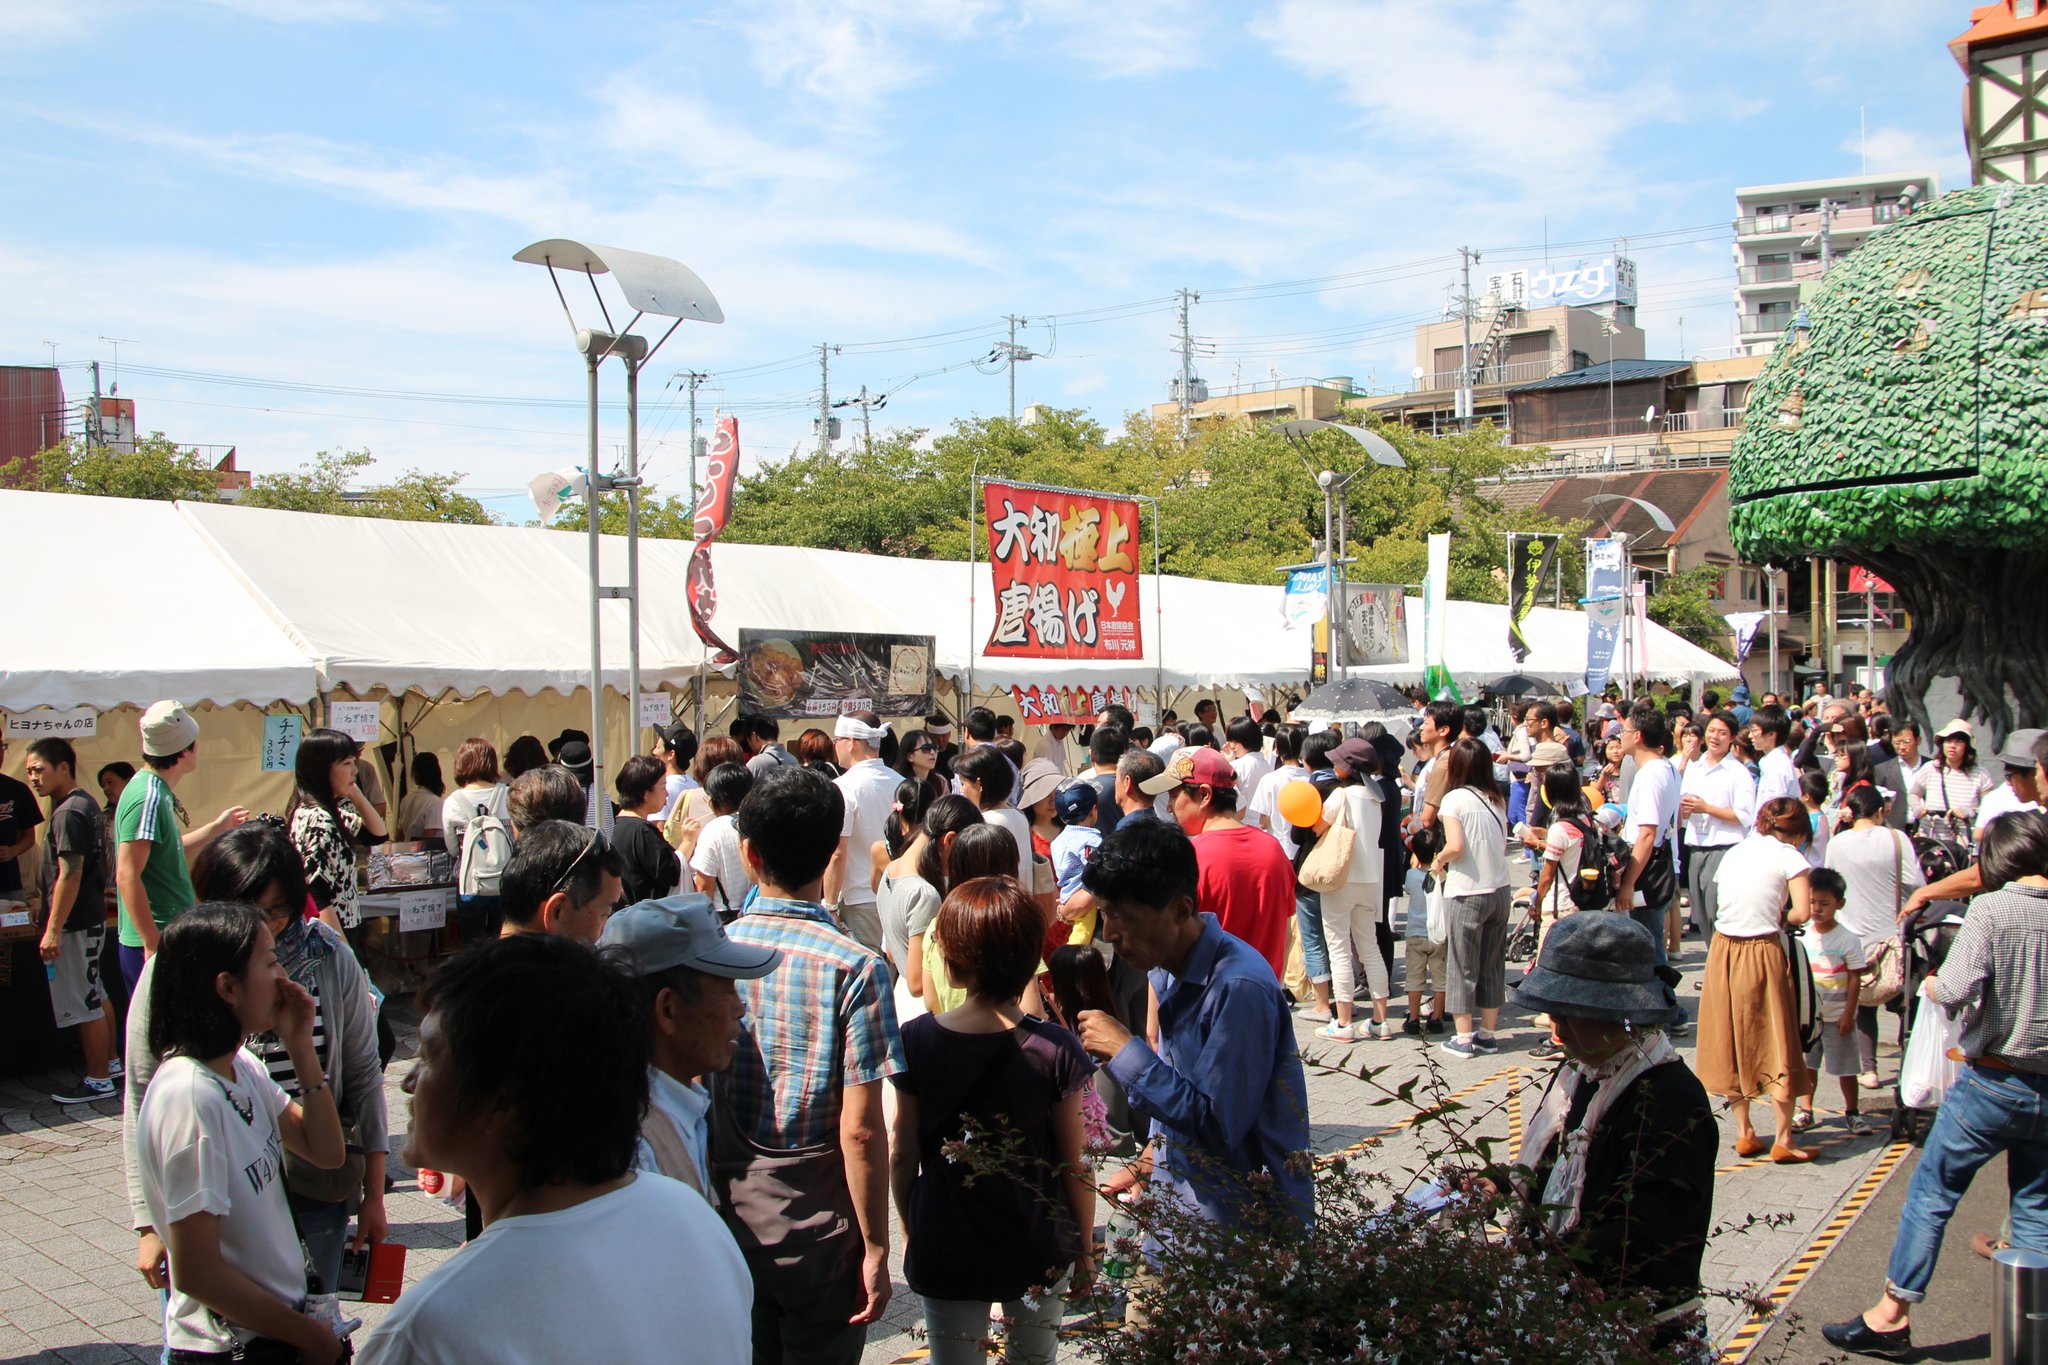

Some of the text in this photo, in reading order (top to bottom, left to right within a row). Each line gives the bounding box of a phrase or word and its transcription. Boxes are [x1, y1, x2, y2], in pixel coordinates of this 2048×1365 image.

[993, 500, 1134, 575] 大和極上
[991, 579, 1100, 645] 唐揚げ
[10, 717, 94, 730] ヒヨナちゃんの店
[277, 717, 294, 767] チヂミ
[265, 739, 274, 769] 300円
